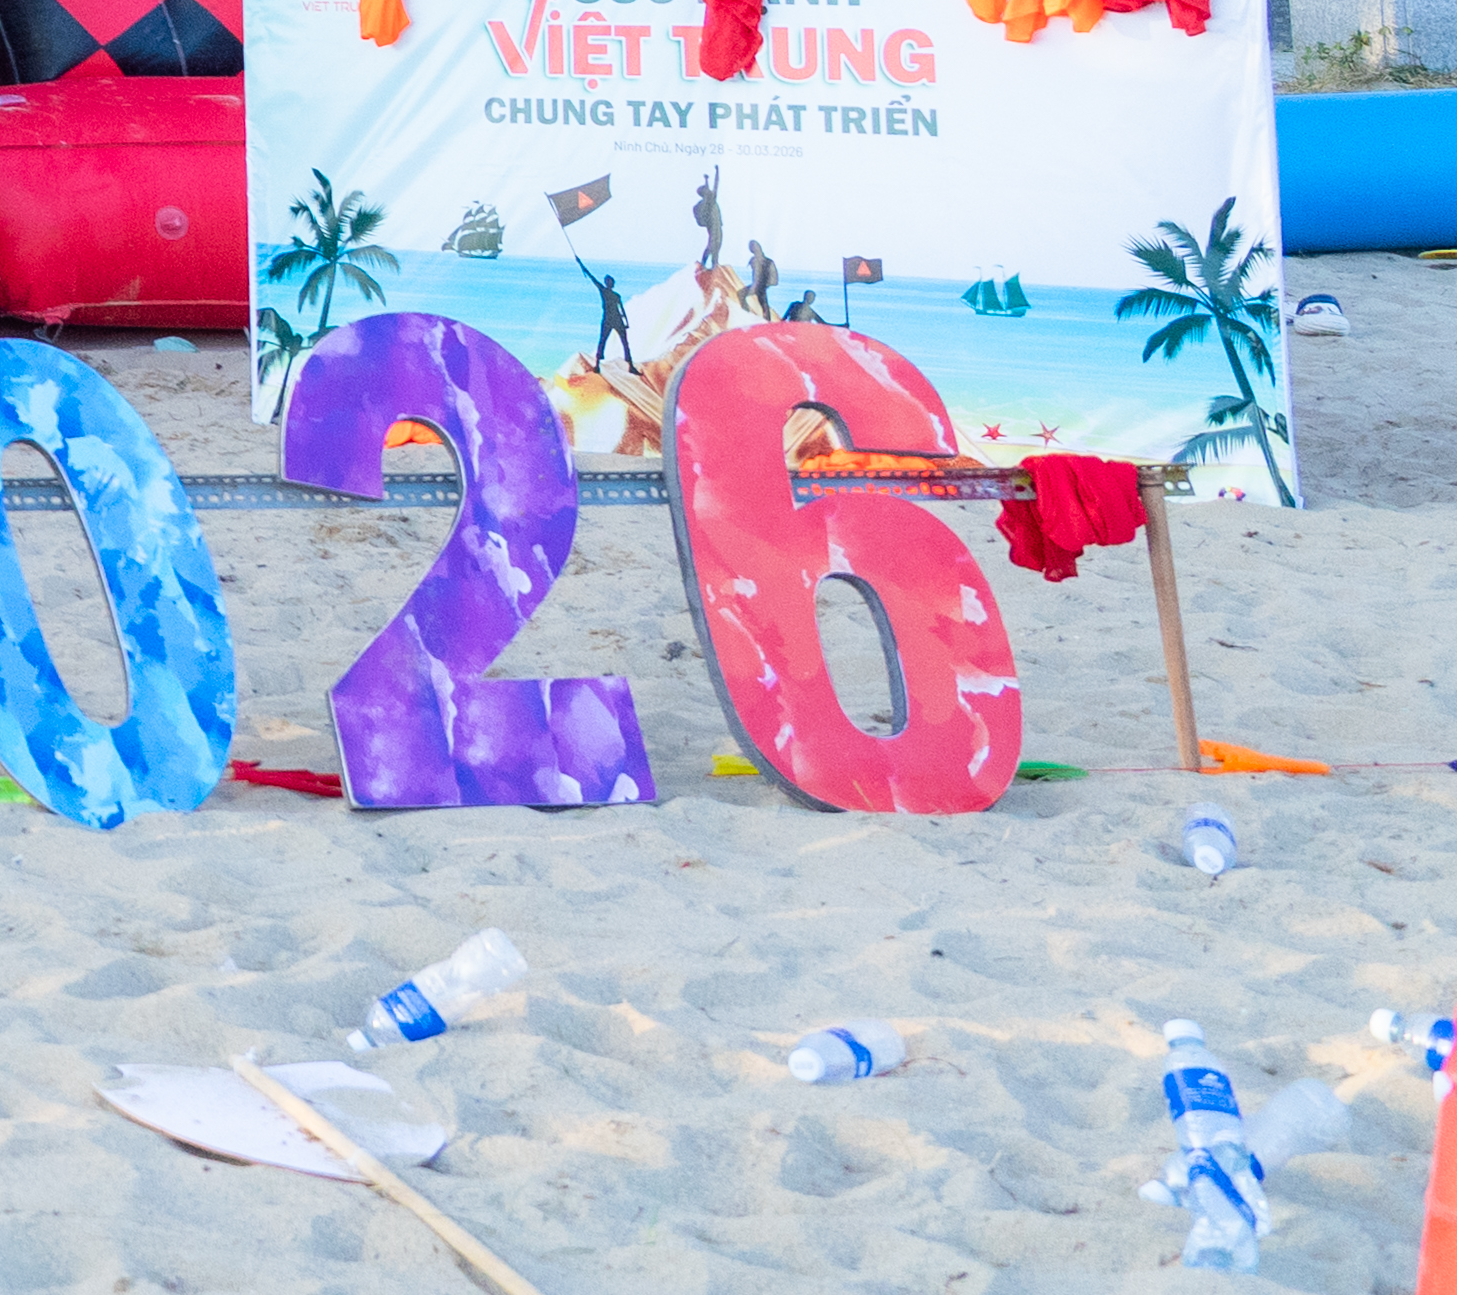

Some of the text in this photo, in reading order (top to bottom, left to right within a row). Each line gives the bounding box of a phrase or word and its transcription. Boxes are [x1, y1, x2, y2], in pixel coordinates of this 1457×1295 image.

[334, 1, 358, 12] TRU
[672, 25, 936, 83] TUNG
[484, 94, 938, 137] CHUNG TAY PHÁT TRIỂN
[614, 140, 641, 152] Ninh
[709, 143, 725, 154] 28
[736, 144, 804, 158] 30.03.2026
